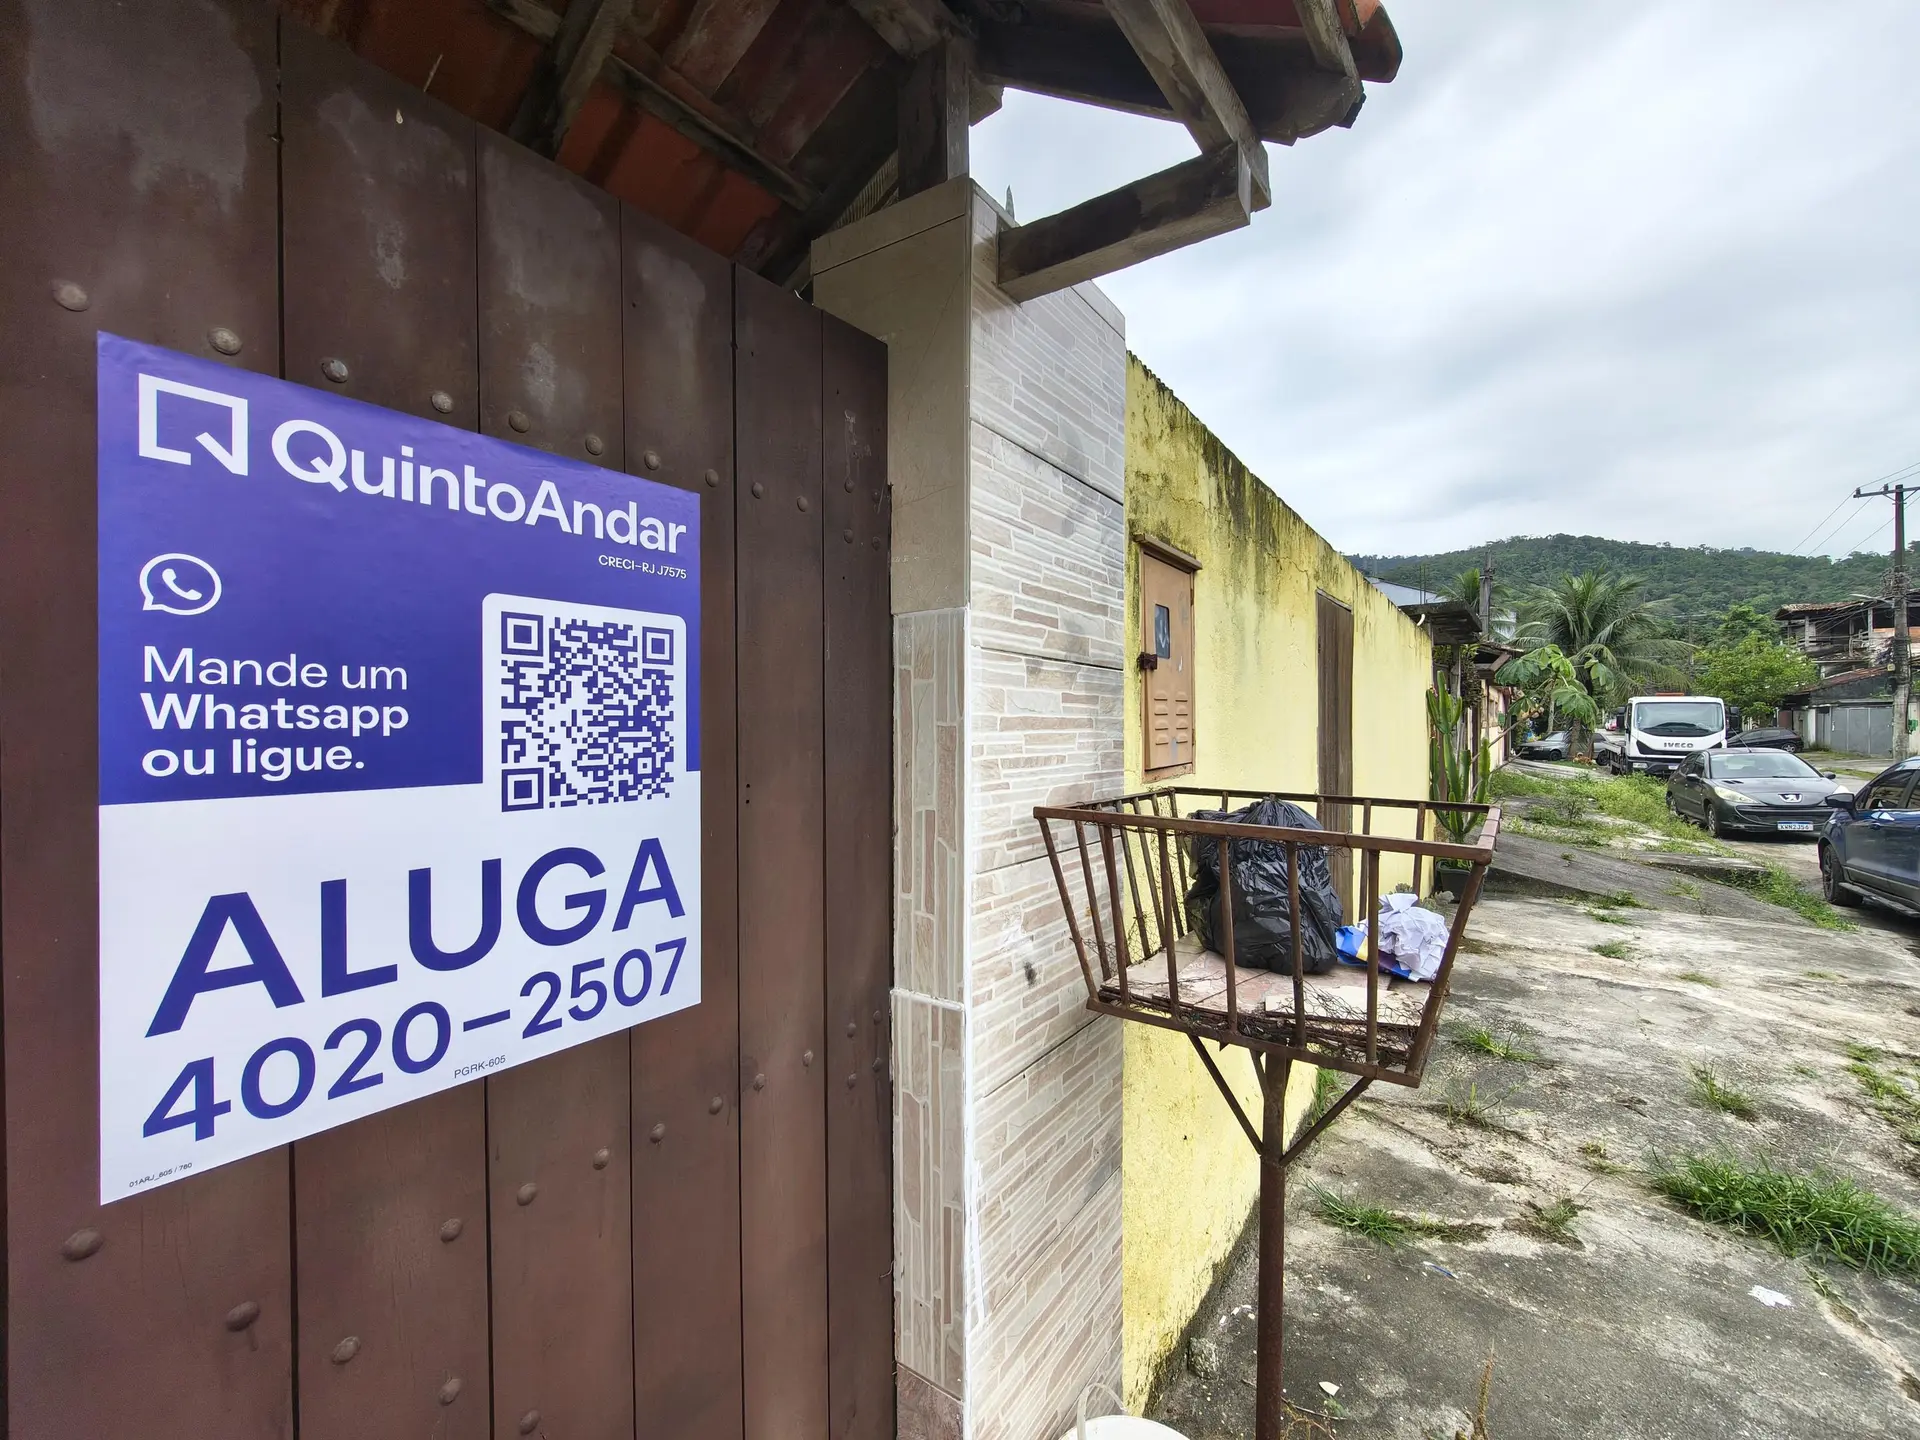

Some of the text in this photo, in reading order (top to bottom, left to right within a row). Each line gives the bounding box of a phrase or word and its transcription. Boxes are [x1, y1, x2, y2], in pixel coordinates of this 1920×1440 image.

[271, 418, 687, 553] QuintoAndar
[598, 554, 687, 579] CRECI-RJ J7575
[144, 645, 408, 690] Mande um
[140, 692, 409, 736] Whatsapp
[141, 738, 365, 782] ou ligue.
[144, 837, 686, 1038] ALUGA
[142, 937, 687, 1141] 4020-2507
[454, 1054, 506, 1079] PGRK-605
